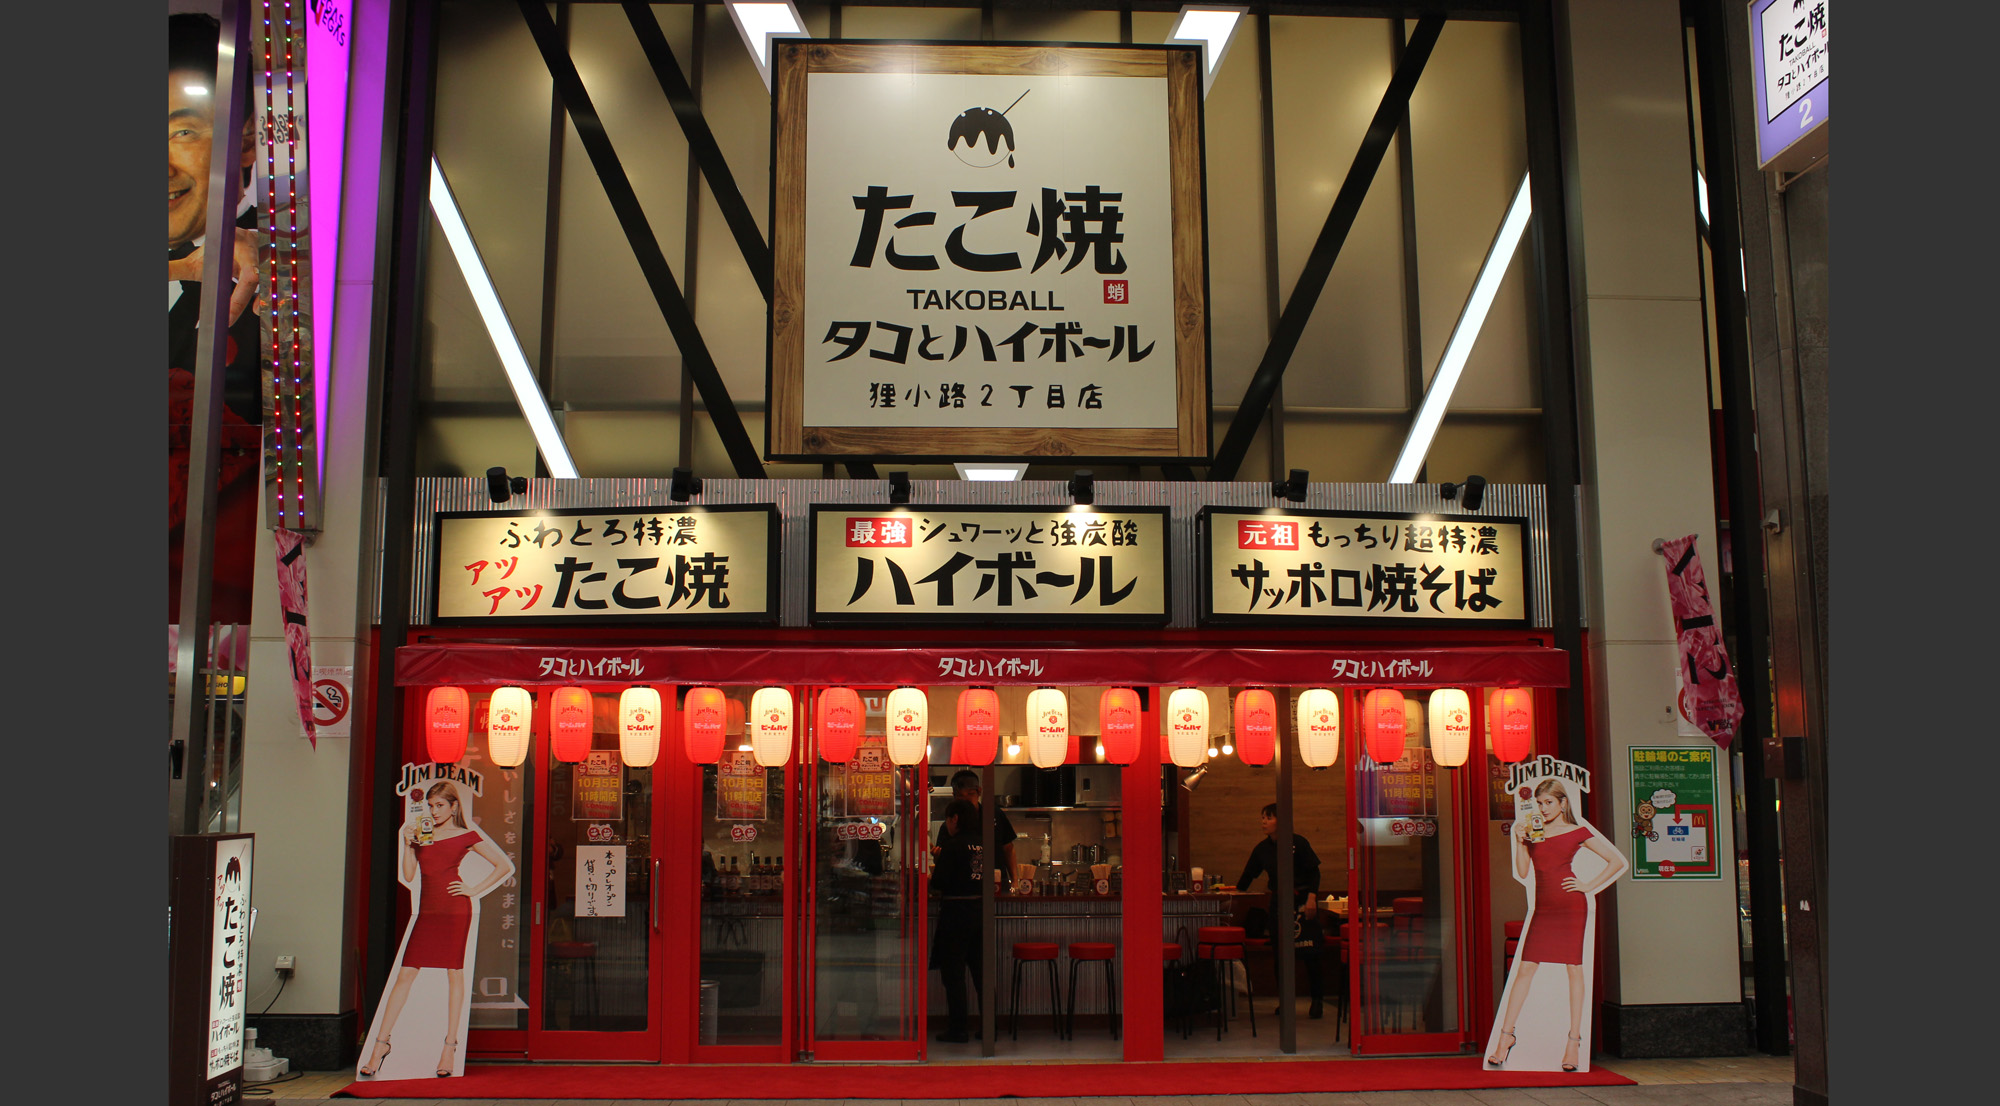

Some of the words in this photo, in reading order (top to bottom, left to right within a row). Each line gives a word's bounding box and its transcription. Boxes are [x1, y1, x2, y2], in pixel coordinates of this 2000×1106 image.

[1778, 2, 1826, 62] たこ焼
[1799, 98, 1814, 129] 2
[850, 185, 1128, 274] たこ焼
[906, 290, 1065, 311] TAKOBALL
[822, 320, 1156, 364] タコとハイボール
[500, 516, 698, 548] ふわとろ特濃
[850, 520, 908, 544] 最強
[920, 518, 1138, 547] シュワーッと強炭酸
[1243, 524, 1295, 546] 元祖
[1308, 521, 1500, 555] もっちり超特濃
[464, 556, 518, 586] アツ
[552, 552, 730, 610] たこ焼
[846, 551, 1138, 606] ハイボール
[1231, 558, 1502, 614] サッポロ焼そば
[482, 584, 543, 615] アツ
[538, 657, 644, 677] タコとハイボール
[938, 657, 1044, 678] タコとハイボール
[1332, 658, 1434, 679] タコとハイボール
[1634, 750, 1711, 762] 駐輪場のご案内
[399, 765, 430, 792] JIM
[434, 761, 480, 792] BEAM
[578, 778, 620, 788] 10月5日
[722, 778, 764, 788] 10月5日
[850, 774, 892, 784] 10月5日
[1382, 774, 1422, 785] 10月5日
[1508, 764, 1537, 792] JIM
[1540, 756, 1586, 788] BEAM
[218, 896, 238, 1011] たこ焼
[212, 1021, 240, 1042] ハイボール
